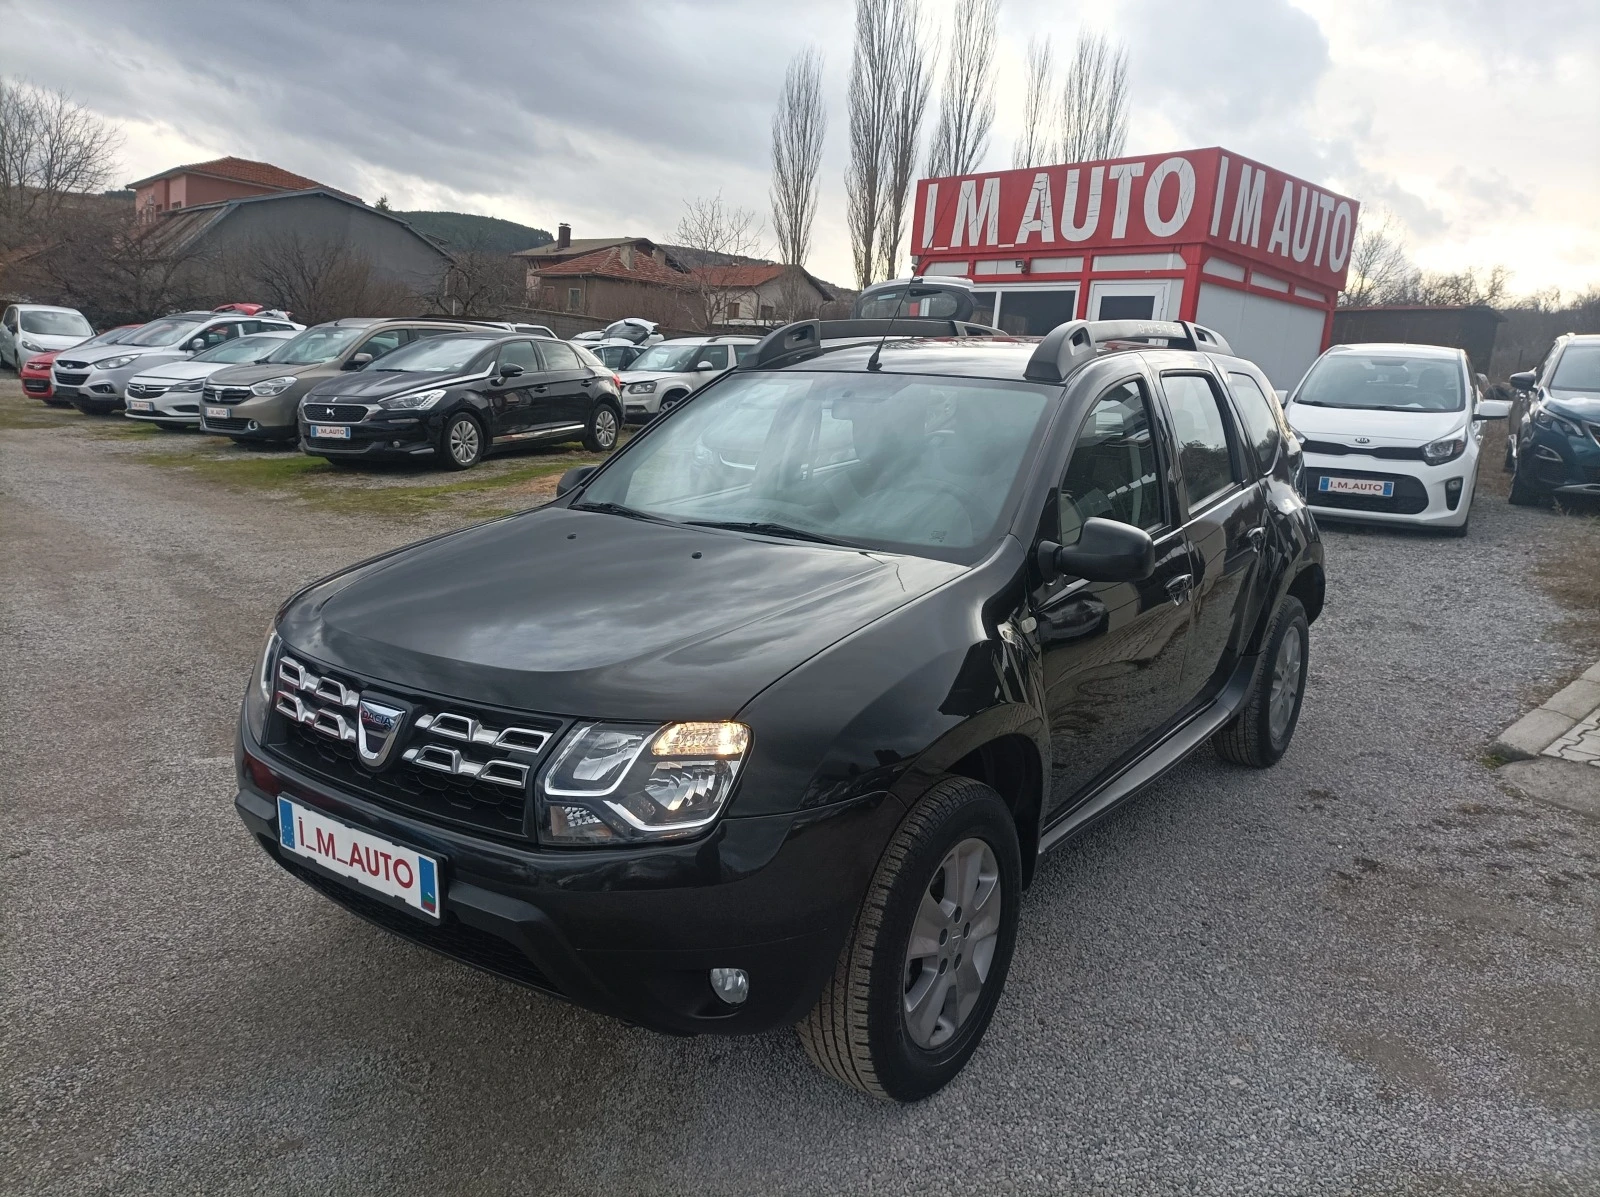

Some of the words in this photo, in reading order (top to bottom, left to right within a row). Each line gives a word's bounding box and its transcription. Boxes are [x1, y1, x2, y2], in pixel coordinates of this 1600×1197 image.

[1210, 156, 1229, 237] I
[1229, 164, 1266, 248] M
[1267, 180, 1351, 273] AUTO
[363, 711, 391, 726] DACIA
